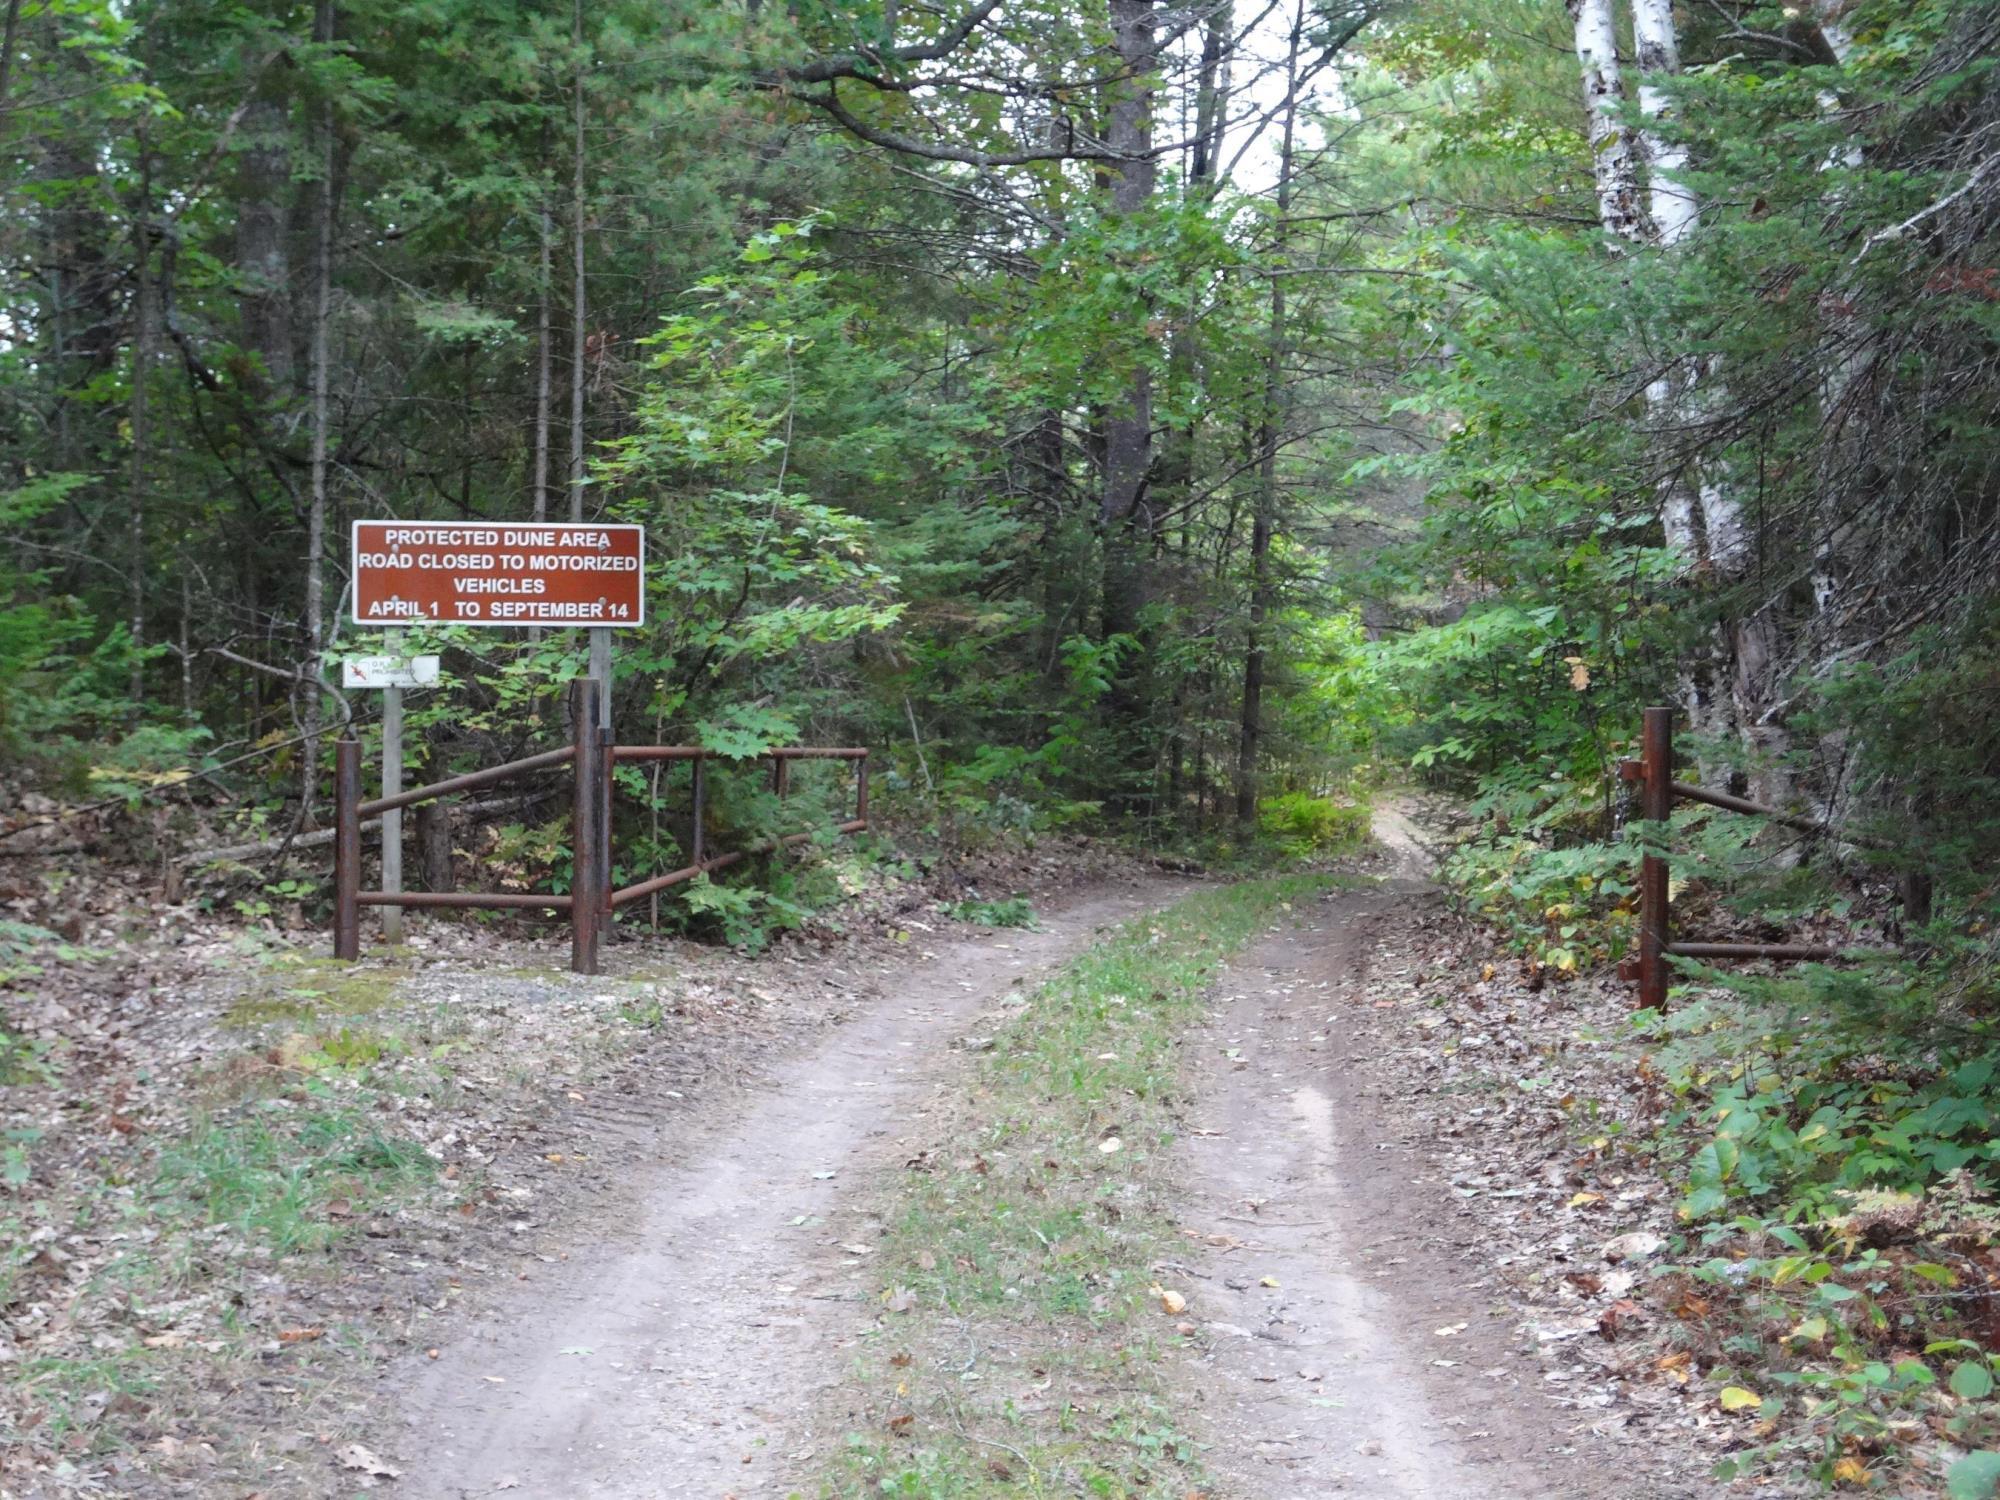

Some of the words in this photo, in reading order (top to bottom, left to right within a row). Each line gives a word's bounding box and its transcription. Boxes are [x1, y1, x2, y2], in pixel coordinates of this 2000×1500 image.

[385, 530, 497, 547] PROTECTED
[504, 531, 556, 547] DUNE
[559, 532, 611, 548] AREA
[358, 553, 413, 569] ROAD
[418, 554, 495, 570] CLOSED
[499, 555, 525, 570] TO
[530, 555, 638, 571] MOTORIZED
[454, 578, 546, 594] VEHICLES
[368, 601, 425, 617] APRIL
[430, 601, 438, 617] 1
[454, 601, 480, 617] TO
[490, 601, 603, 618] SEPTEMBER
[608, 603, 629, 618] 14
